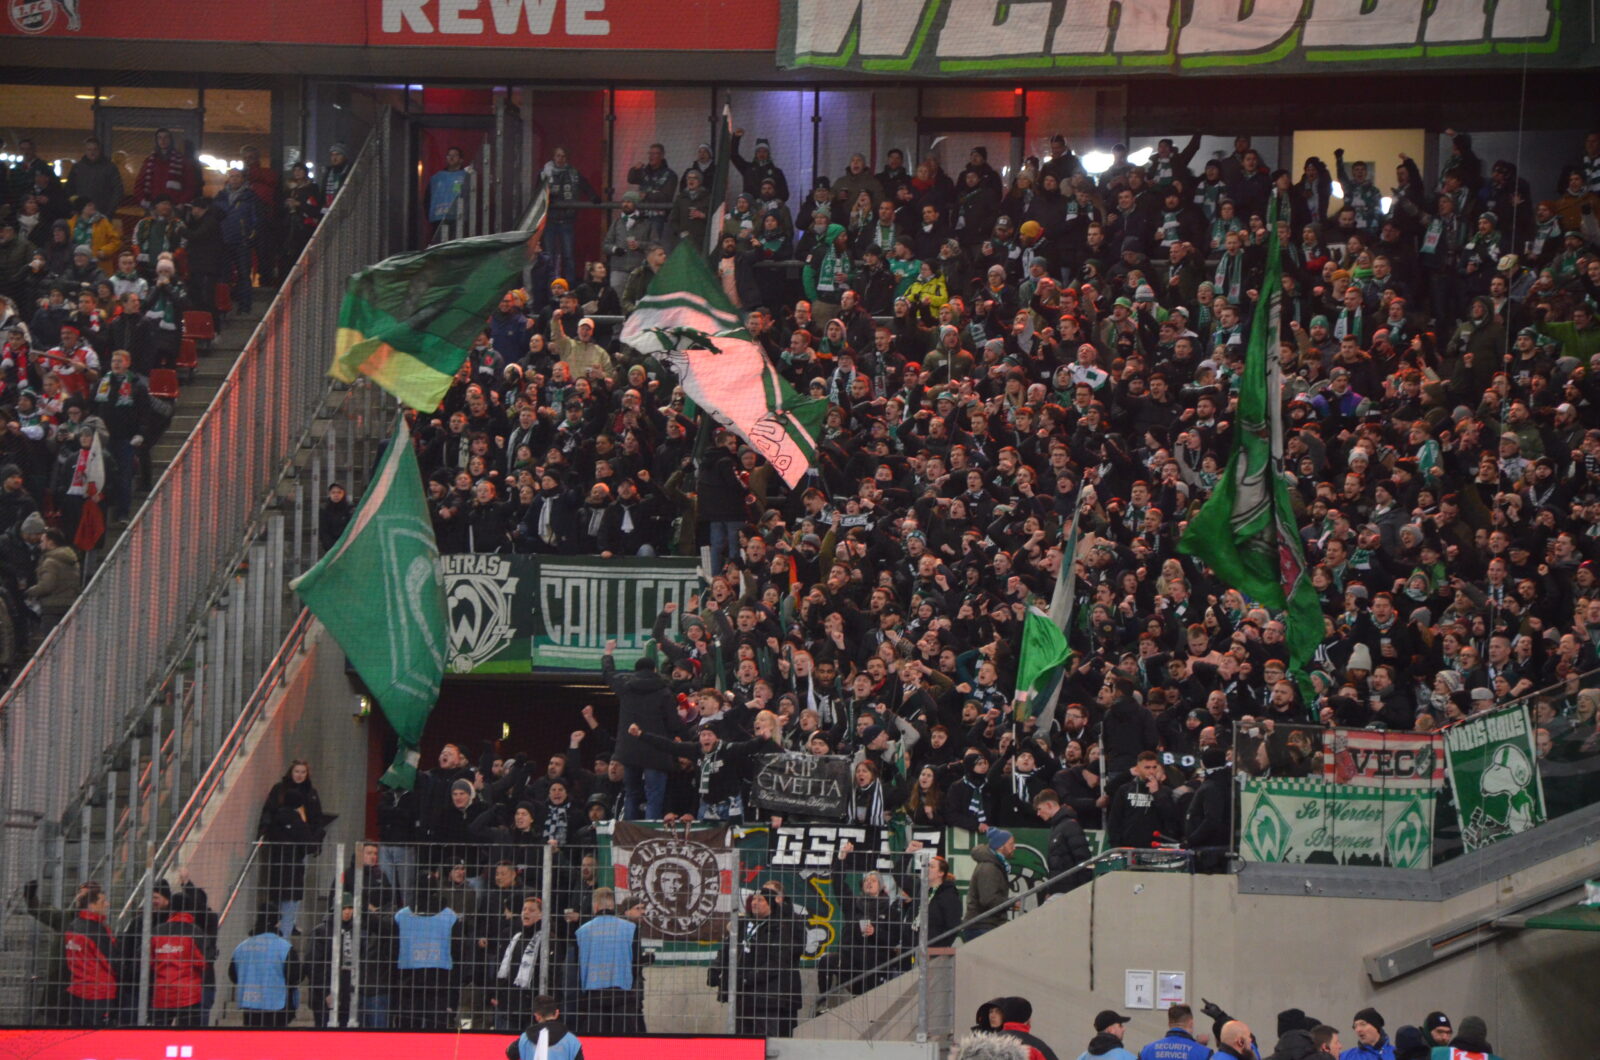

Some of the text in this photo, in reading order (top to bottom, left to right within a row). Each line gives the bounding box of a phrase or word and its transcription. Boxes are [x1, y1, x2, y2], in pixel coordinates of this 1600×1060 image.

[1446, 708, 1525, 753] NAZIS RAUS
[784, 760, 818, 777] RIP
[757, 772, 842, 798] CIVETTA
[1304, 827, 1374, 849] Bremen
[1154, 1042, 1194, 1052] SECURITY
[1154, 1051, 1188, 1060] SERVICE
